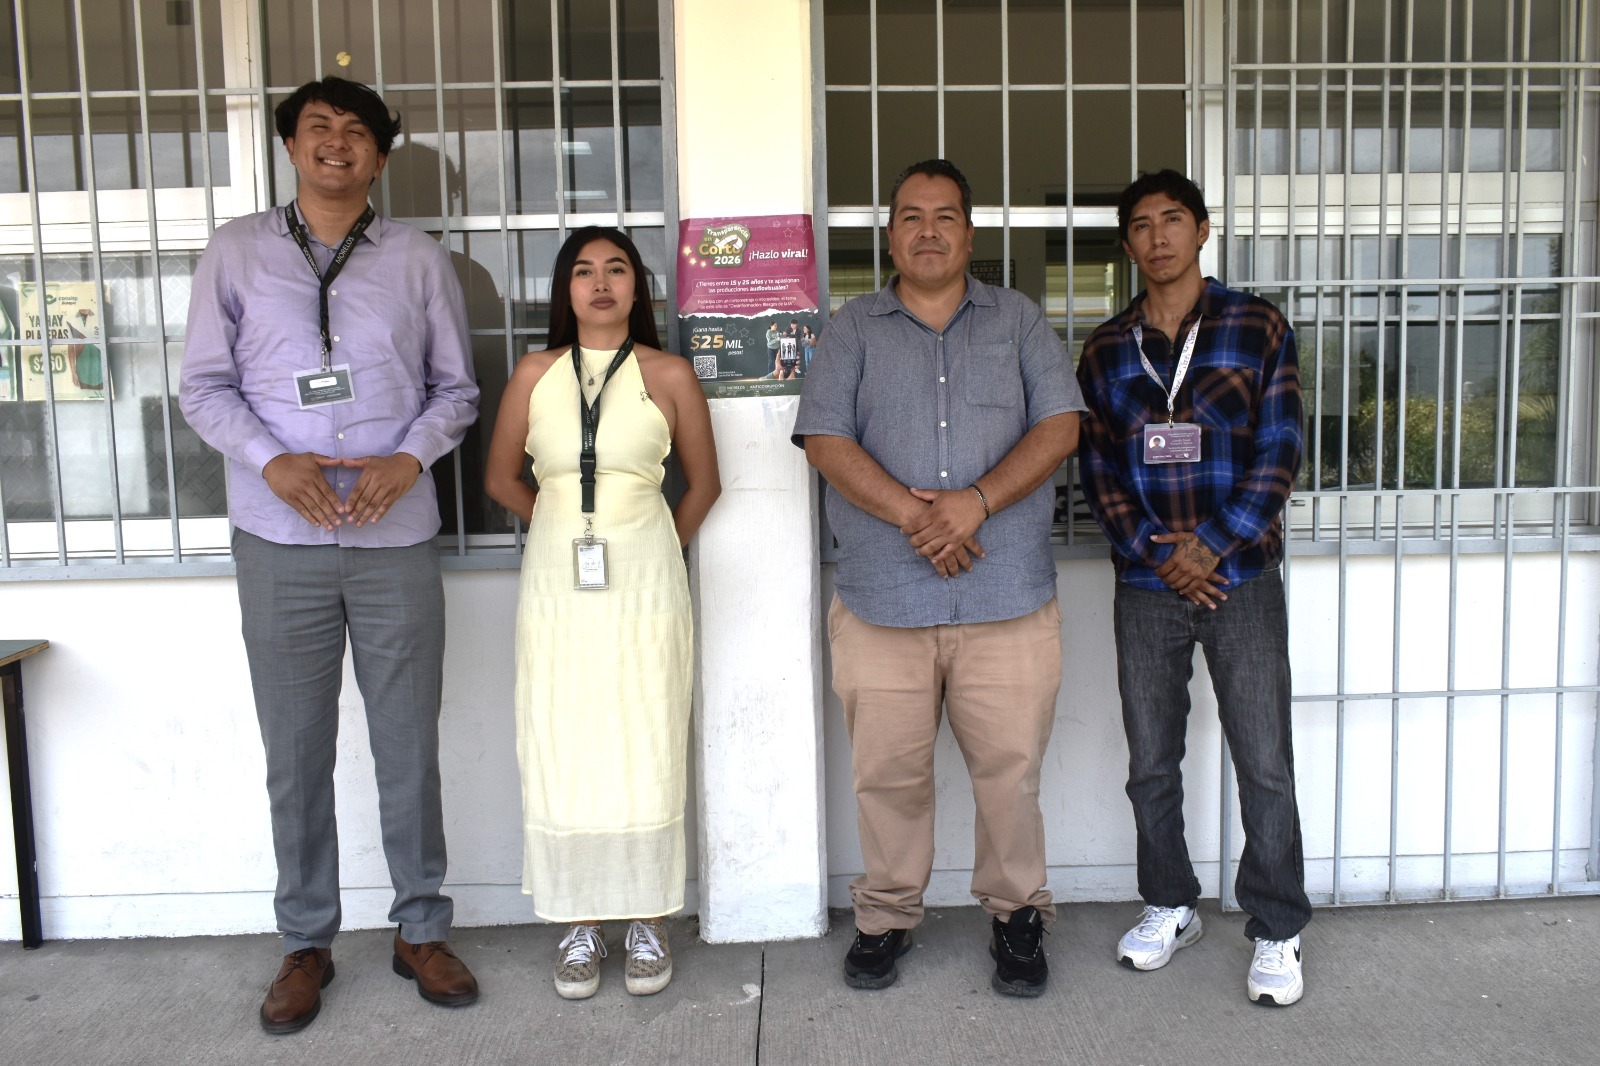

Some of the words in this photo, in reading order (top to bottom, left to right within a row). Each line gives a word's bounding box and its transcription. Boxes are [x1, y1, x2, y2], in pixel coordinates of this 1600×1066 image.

[707, 226, 749, 238] Transparencia
[335, 236, 354, 264] MORELOS
[749, 250, 779, 261] ¡Hazlo
[781, 249, 808, 258] viral!
[714, 256, 741, 265] 2026
[26, 328, 69, 340] PLAERAS
[690, 334, 724, 351] $25
[725, 340, 744, 349] MIL
[34, 355, 64, 372] $60
